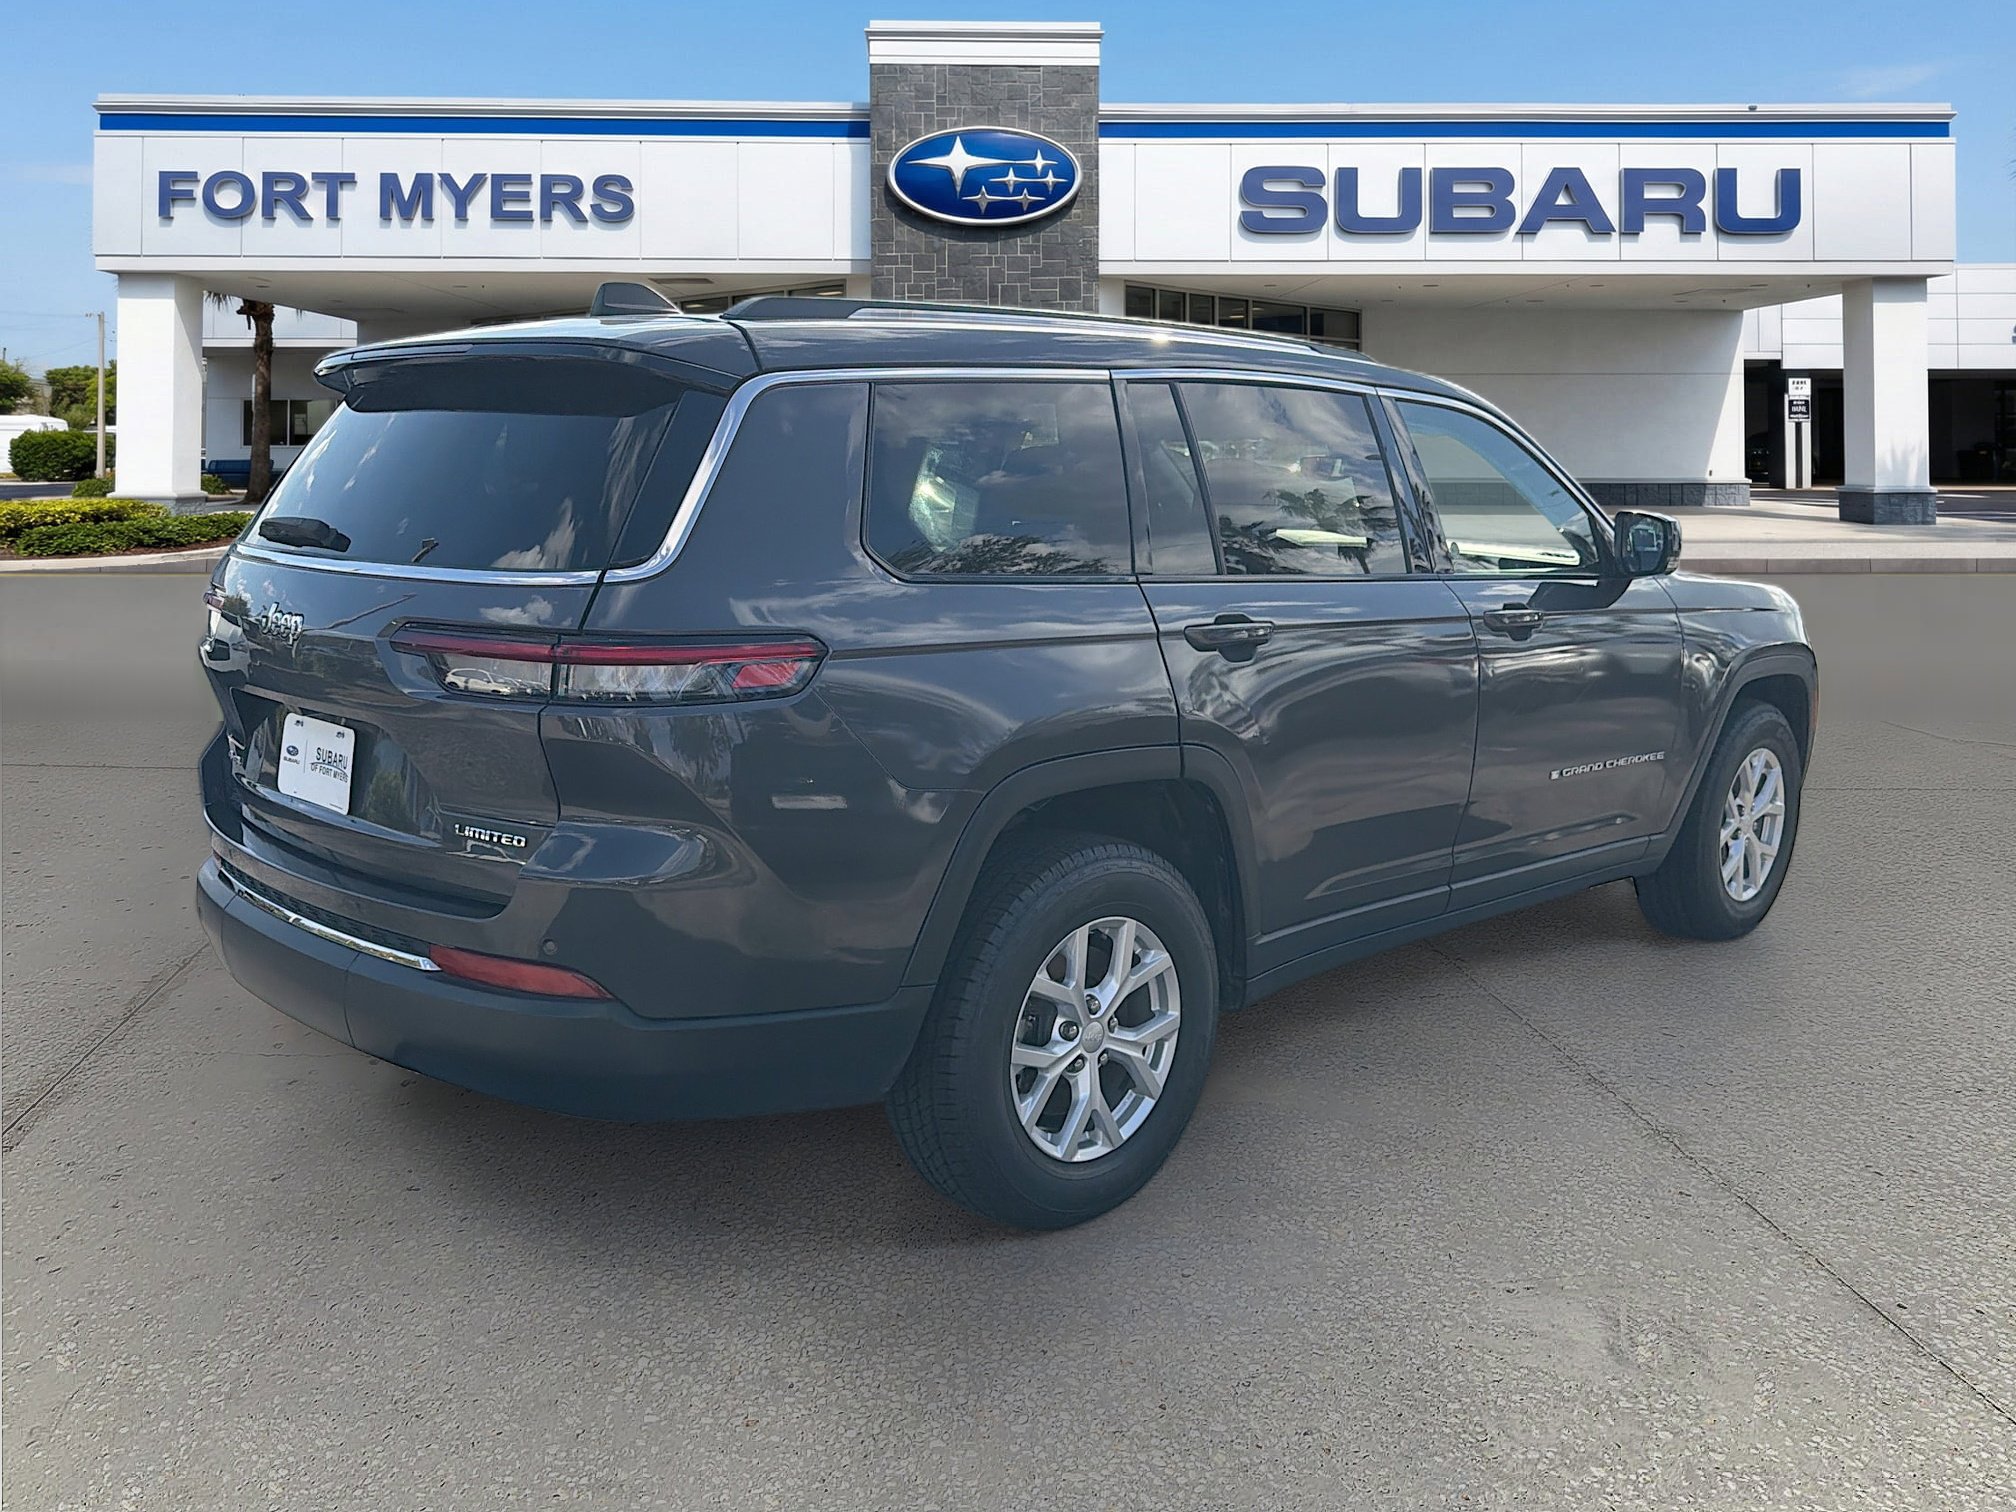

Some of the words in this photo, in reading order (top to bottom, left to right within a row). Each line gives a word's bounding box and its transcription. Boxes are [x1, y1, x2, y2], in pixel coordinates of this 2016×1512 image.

[158, 170, 357, 221] FORT
[379, 172, 636, 223] MYERS
[1240, 165, 1802, 236] SUBARU
[262, 601, 304, 647] Jeep
[315, 747, 348, 770] SUBARU
[1562, 761, 1604, 777] GRAND
[1605, 751, 1665, 769] CHEROKEE
[310, 763, 318, 772] OF
[319, 765, 332, 778] FORT
[333, 769, 349, 783] MYERS
[455, 823, 526, 848] LIMITED
